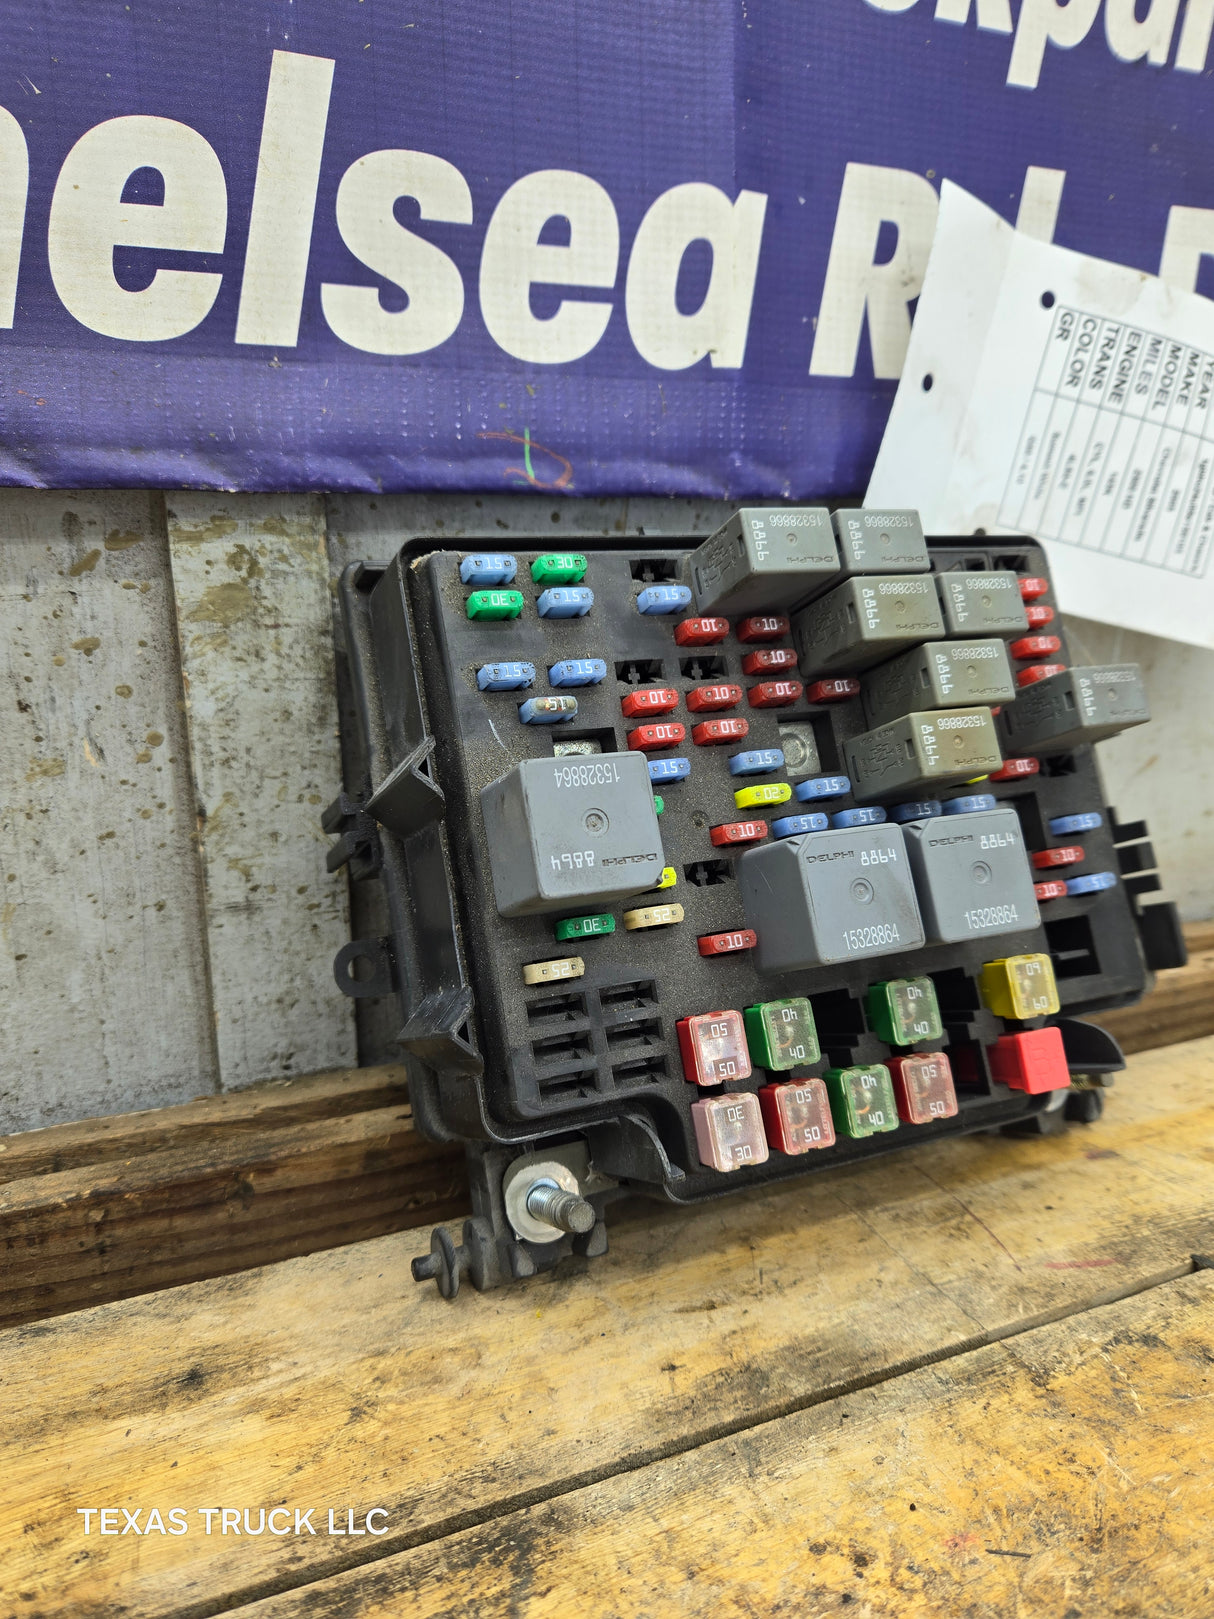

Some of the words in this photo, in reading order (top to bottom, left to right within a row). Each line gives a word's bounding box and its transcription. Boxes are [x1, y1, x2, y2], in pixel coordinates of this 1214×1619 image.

[1055, 311, 1075, 342] GR
[1065, 319, 1097, 388] COLOR
[1089, 326, 1120, 391] TRANS
[1107, 331, 1142, 405] ENGINE
[1135, 338, 1162, 395] MILES
[1152, 344, 1182, 411] MODEL
[1176, 352, 1200, 406] MAKE
[484, 558, 502, 569] 15
[558, 557, 573, 568] 30
[491, 594, 508, 605] 30
[564, 591, 579, 602] 15
[663, 590, 678, 600] 15
[1031, 608, 1044, 619] 10
[702, 620, 717, 632] 10
[764, 618, 777, 630] 10
[1039, 637, 1054, 648] 10
[771, 652, 785, 663] 10
[505, 666, 521, 677] 15
[577, 662, 592, 674] 15
[776, 682, 791, 694] 10
[835, 680, 849, 692] 10
[651, 691, 666, 703] 10
[713, 687, 728, 699] 10
[657, 726, 672, 737] 10
[720, 721, 736, 733] 10
[757, 753, 772, 764] 15
[661, 763, 678, 775] 15
[1016, 760, 1030, 772] 10
[554, 764, 620, 787] 15328864
[824, 781, 839, 791] 15
[764, 788, 779, 799] 20
[917, 803, 930, 814] 15
[972, 798, 985, 808] 15
[859, 810, 875, 821] 15
[1080, 816, 1093, 826] 15
[801, 817, 817, 828] 15
[739, 825, 754, 836] 10
[929, 835, 973, 847] DELPHI
[980, 833, 1014, 848] 8864
[602, 854, 657, 866] DELPHI
[806, 851, 854, 863] DELPHI
[861, 849, 896, 865] 8864
[1062, 849, 1074, 859] 10
[551, 851, 594, 870] 8864
[1092, 877, 1106, 887] 15
[1045, 884, 1058, 895] 10
[653, 908, 670, 920] 25
[964, 904, 1018, 929] 15328864
[584, 918, 601, 932] 30
[727, 935, 742, 947] 10
[842, 924, 900, 949] 15328864
[552, 963, 570, 976] 25
[1026, 963, 1040, 975] 60
[907, 987, 922, 1000] 40
[1034, 997, 1048, 1009] 60
[782, 1009, 798, 1022] 40
[711, 1023, 727, 1038] 50
[914, 1022, 929, 1034] 40
[790, 1046, 805, 1059] 40
[719, 1062, 736, 1076] 50
[923, 1065, 937, 1078] 50
[861, 1075, 876, 1089] 40
[797, 1089, 812, 1103] 50
[727, 1107, 744, 1122] 30
[930, 1102, 944, 1115] 50
[869, 1112, 884, 1125] 40
[805, 1126, 820, 1142] 50
[735, 1145, 752, 1160] 30
